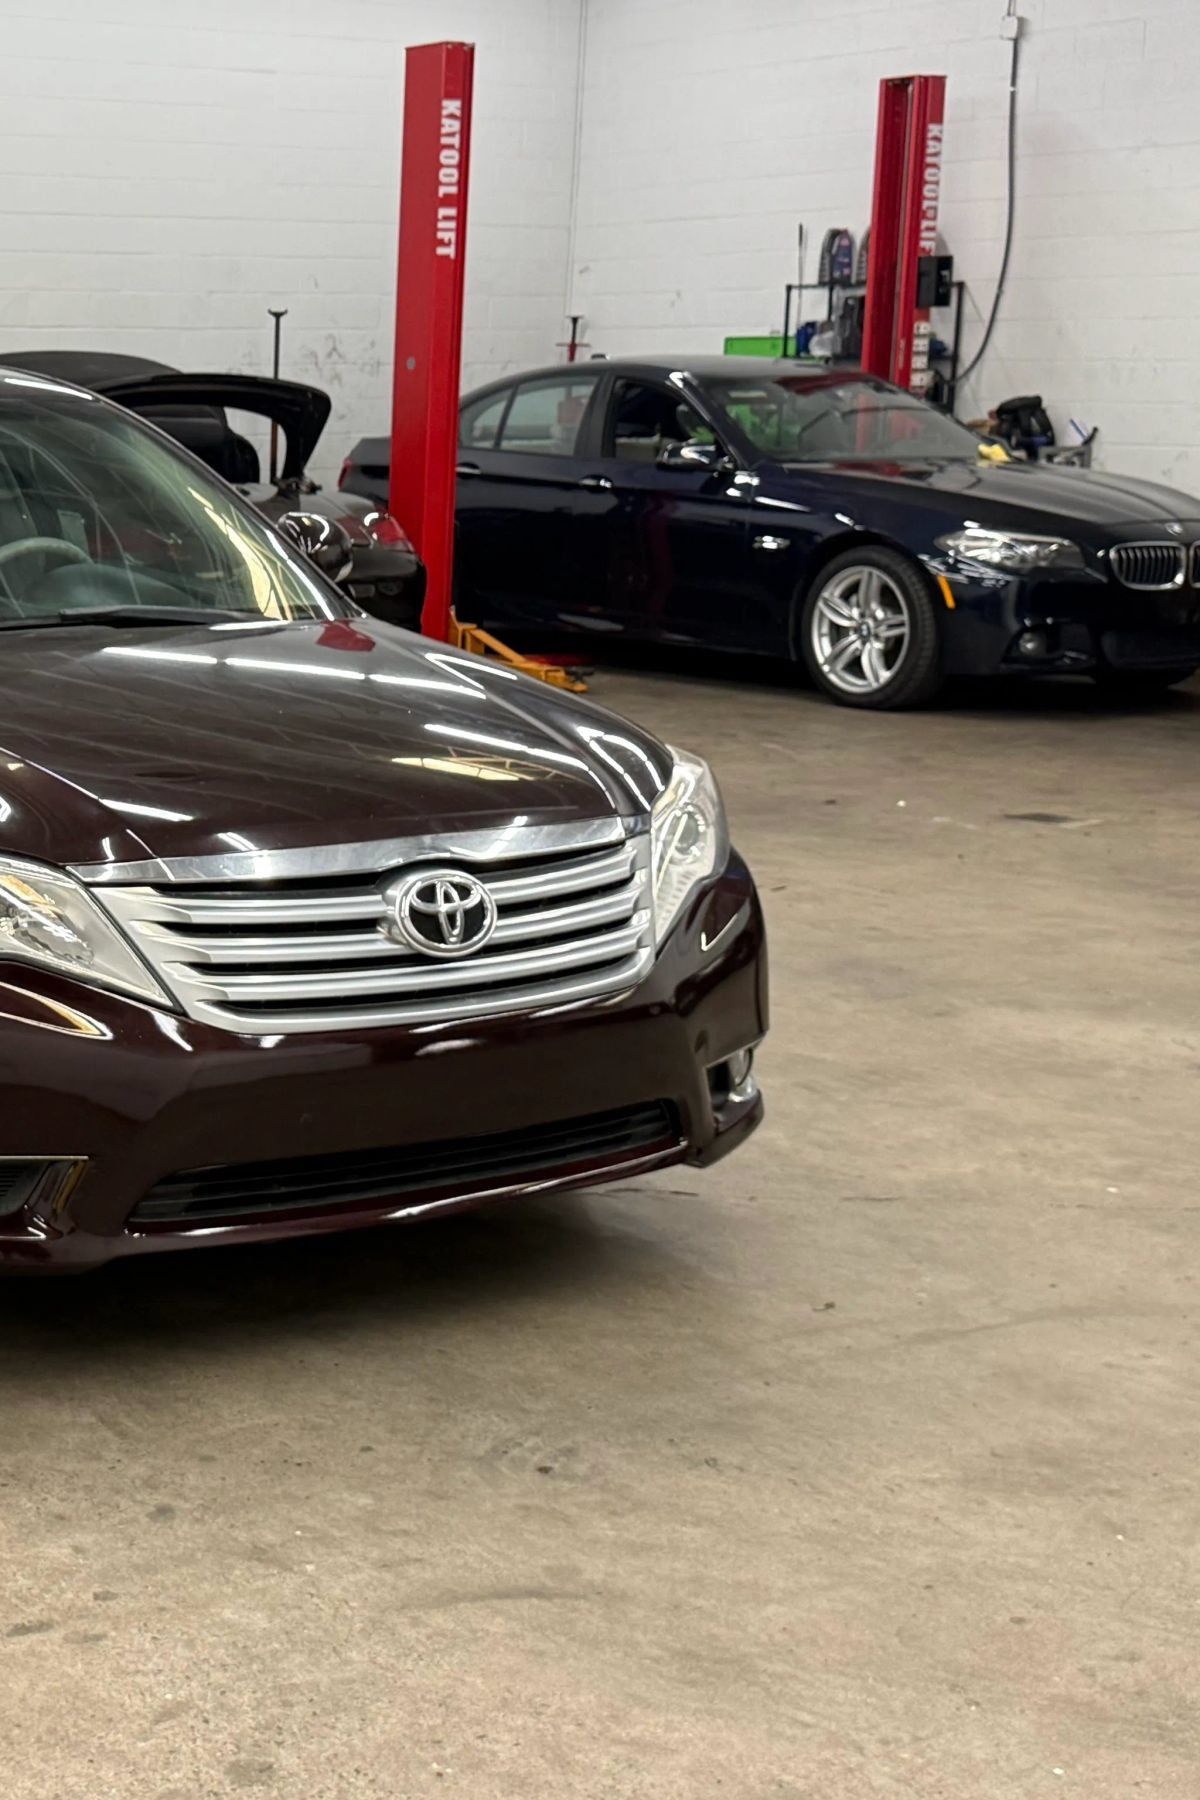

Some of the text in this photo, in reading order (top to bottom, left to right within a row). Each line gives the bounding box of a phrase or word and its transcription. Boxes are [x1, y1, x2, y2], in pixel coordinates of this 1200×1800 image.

[435, 99, 462, 260] KATOOL LIFT
[920, 218, 938, 256] LIF
